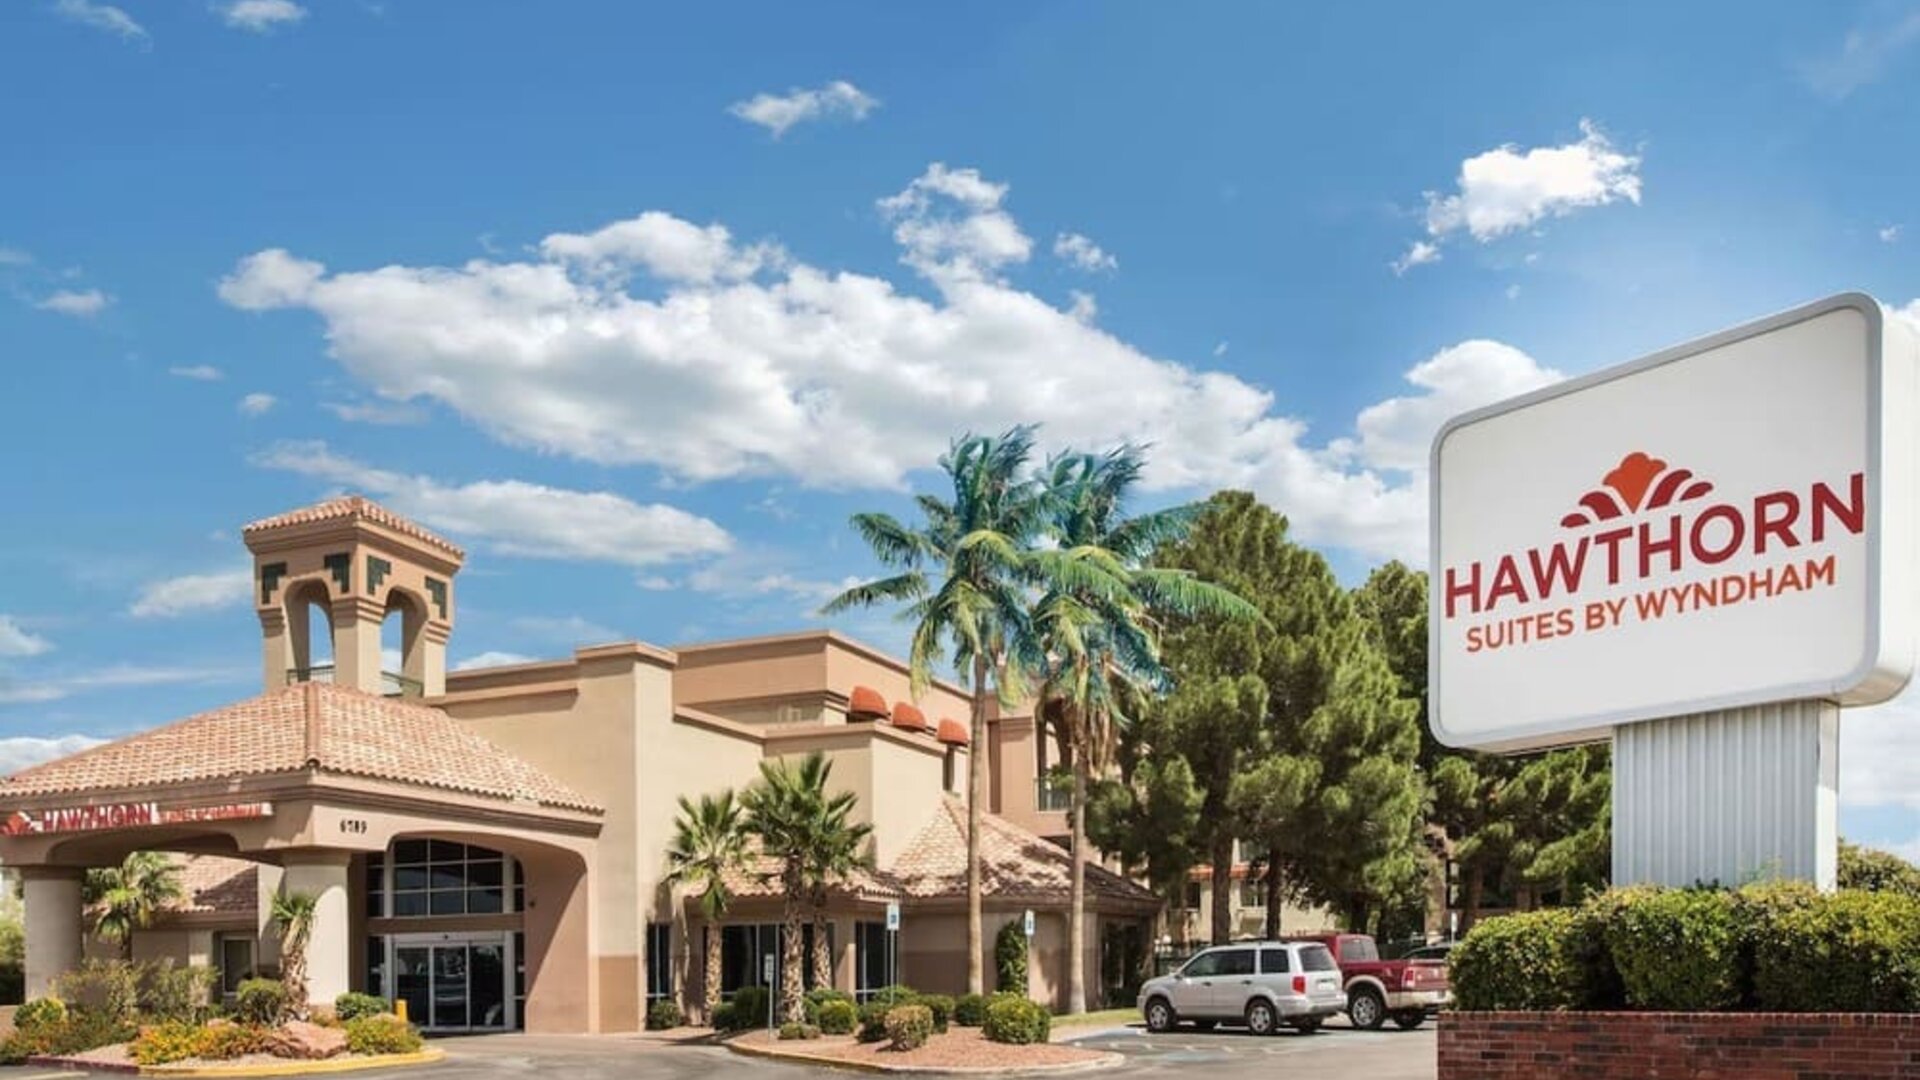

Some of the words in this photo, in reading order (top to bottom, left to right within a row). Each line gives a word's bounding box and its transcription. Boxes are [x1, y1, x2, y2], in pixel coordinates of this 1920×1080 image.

[1445, 472, 1865, 618] HAWTHORN
[1465, 608, 1574, 653] SUITES
[1585, 597, 1627, 631] BY
[1634, 555, 1836, 622] WYNDHAM
[43, 803, 150, 832] HAWTHORN
